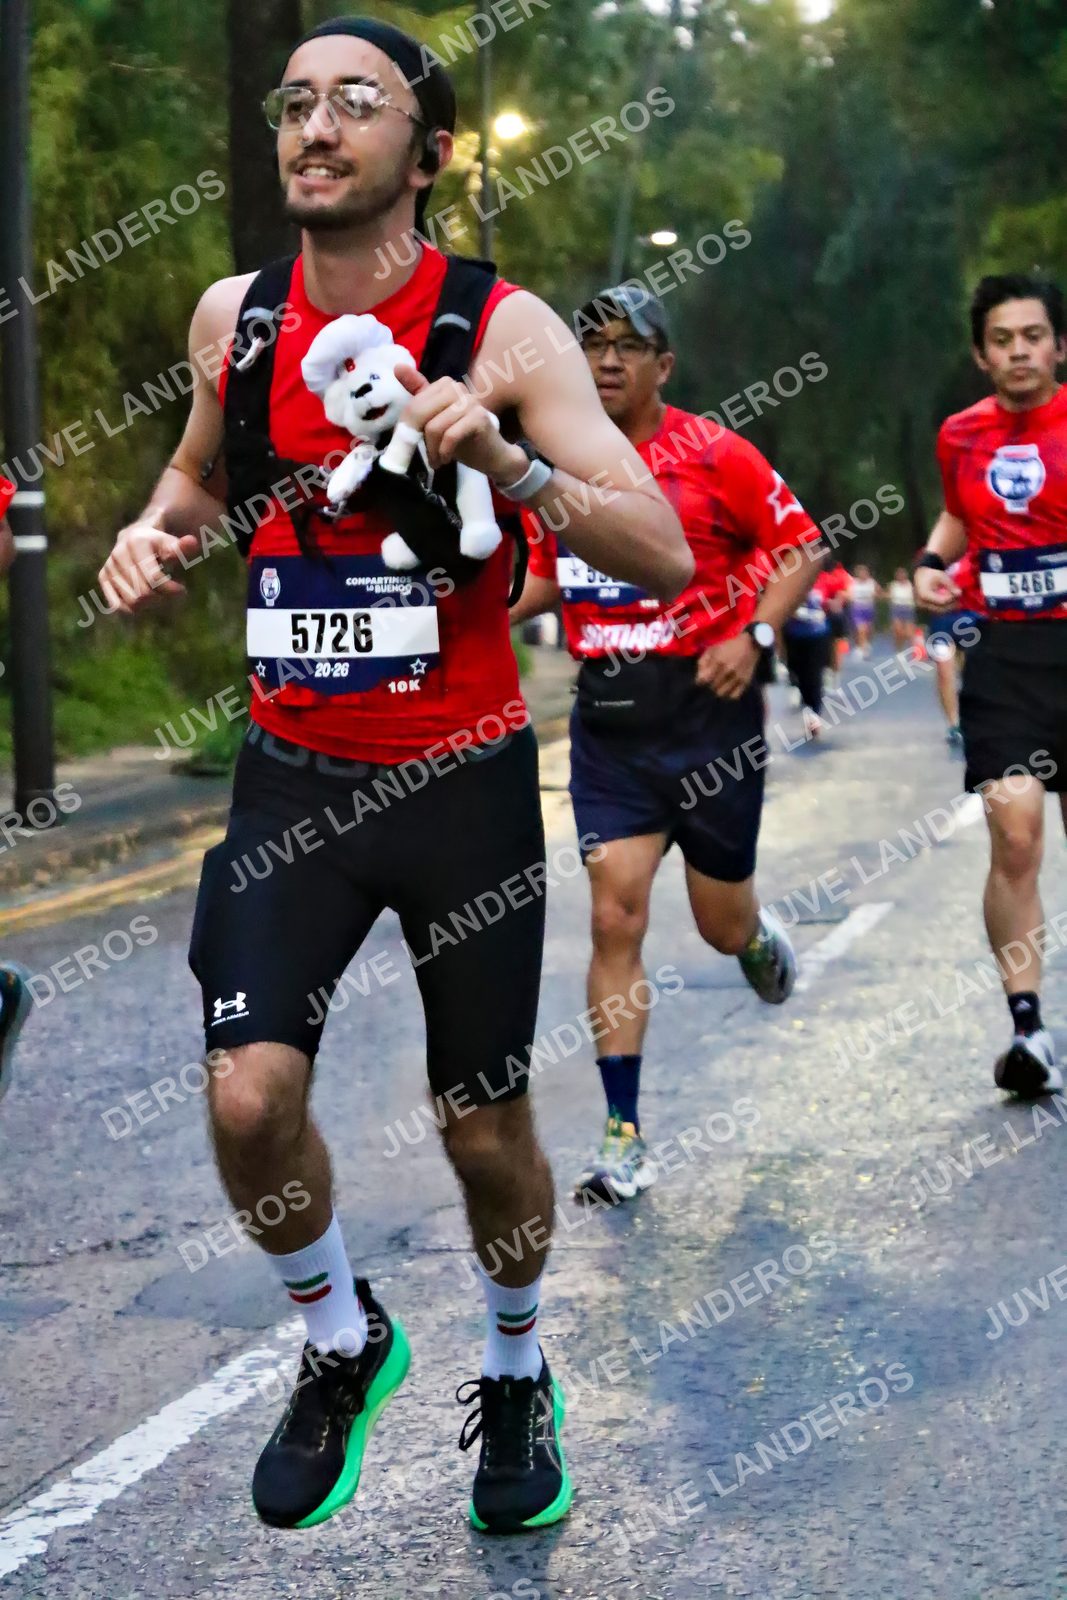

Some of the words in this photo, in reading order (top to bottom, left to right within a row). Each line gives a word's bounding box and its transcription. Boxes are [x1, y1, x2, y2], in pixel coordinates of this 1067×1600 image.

[1008, 570, 1055, 594] 5466
[291, 612, 373, 654] 5726
[388, 678, 420, 694] 10K
